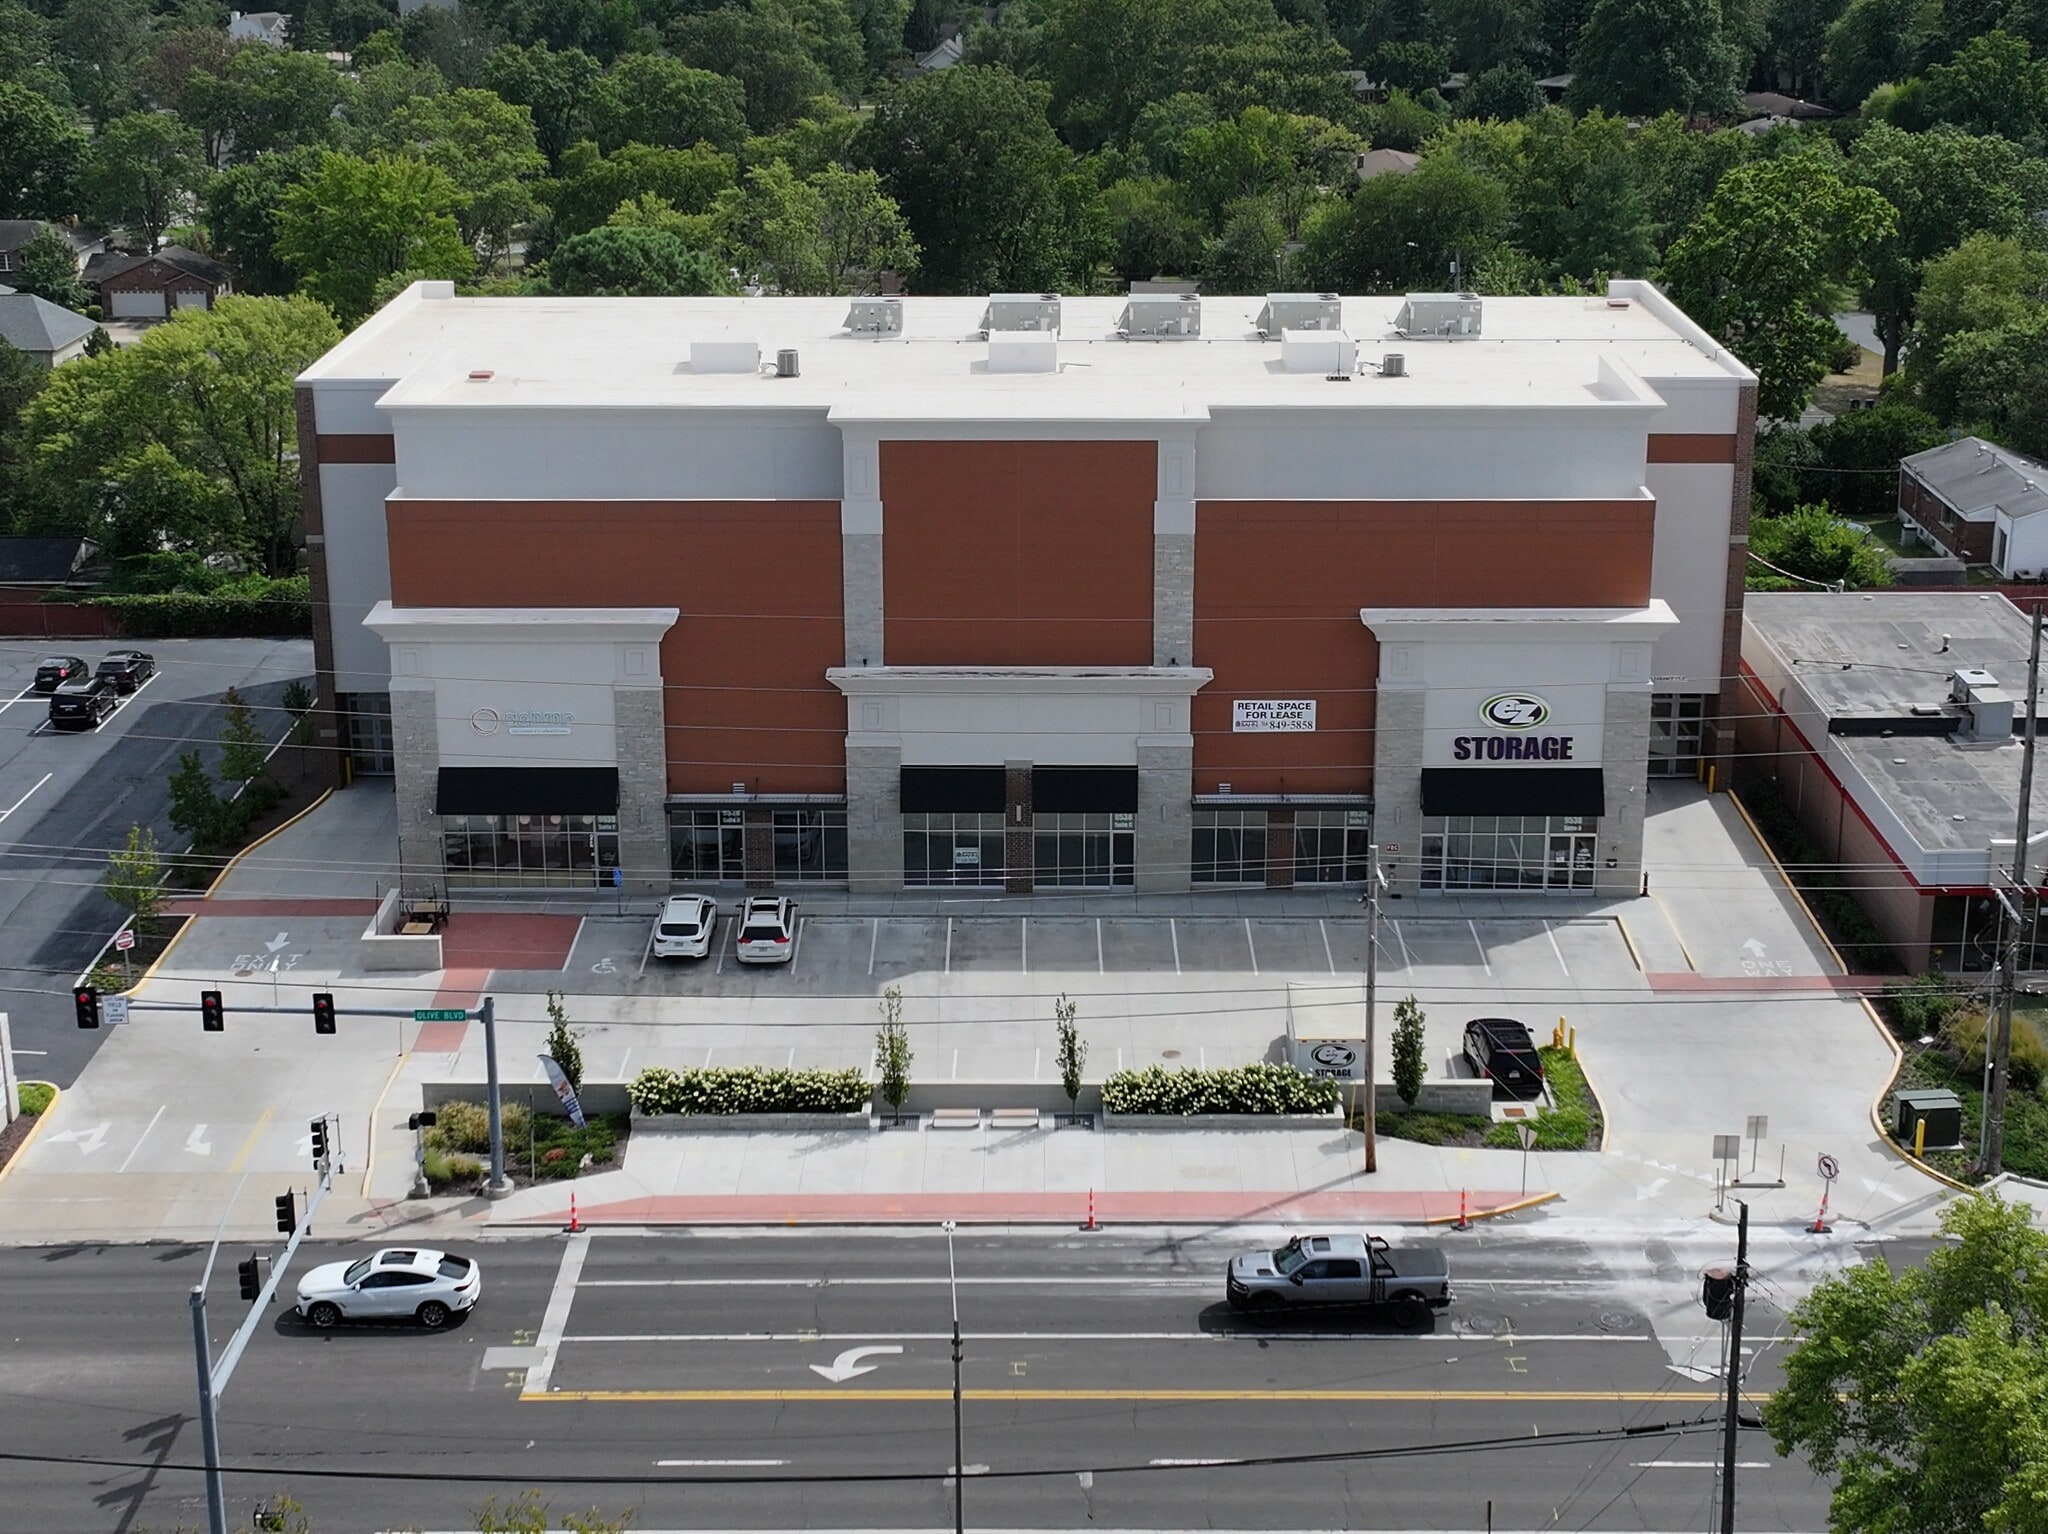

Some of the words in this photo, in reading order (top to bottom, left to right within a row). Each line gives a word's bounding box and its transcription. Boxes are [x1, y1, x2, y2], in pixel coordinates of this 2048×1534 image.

[1237, 702, 1274, 711] RETAIL
[1277, 702, 1312, 711] SPACE
[1246, 711, 1267, 719] FOR
[1270, 711, 1304, 719] LEASE
[1269, 720, 1313, 730] 849-5858
[1454, 736, 1574, 761] STORAGE
[233, 954, 304, 963] EXIT
[1741, 960, 1792, 969] ONE
[1744, 968, 1793, 977] WAY
[416, 1011, 440, 1020] OLIVE
[443, 1011, 465, 1020] BLVD
